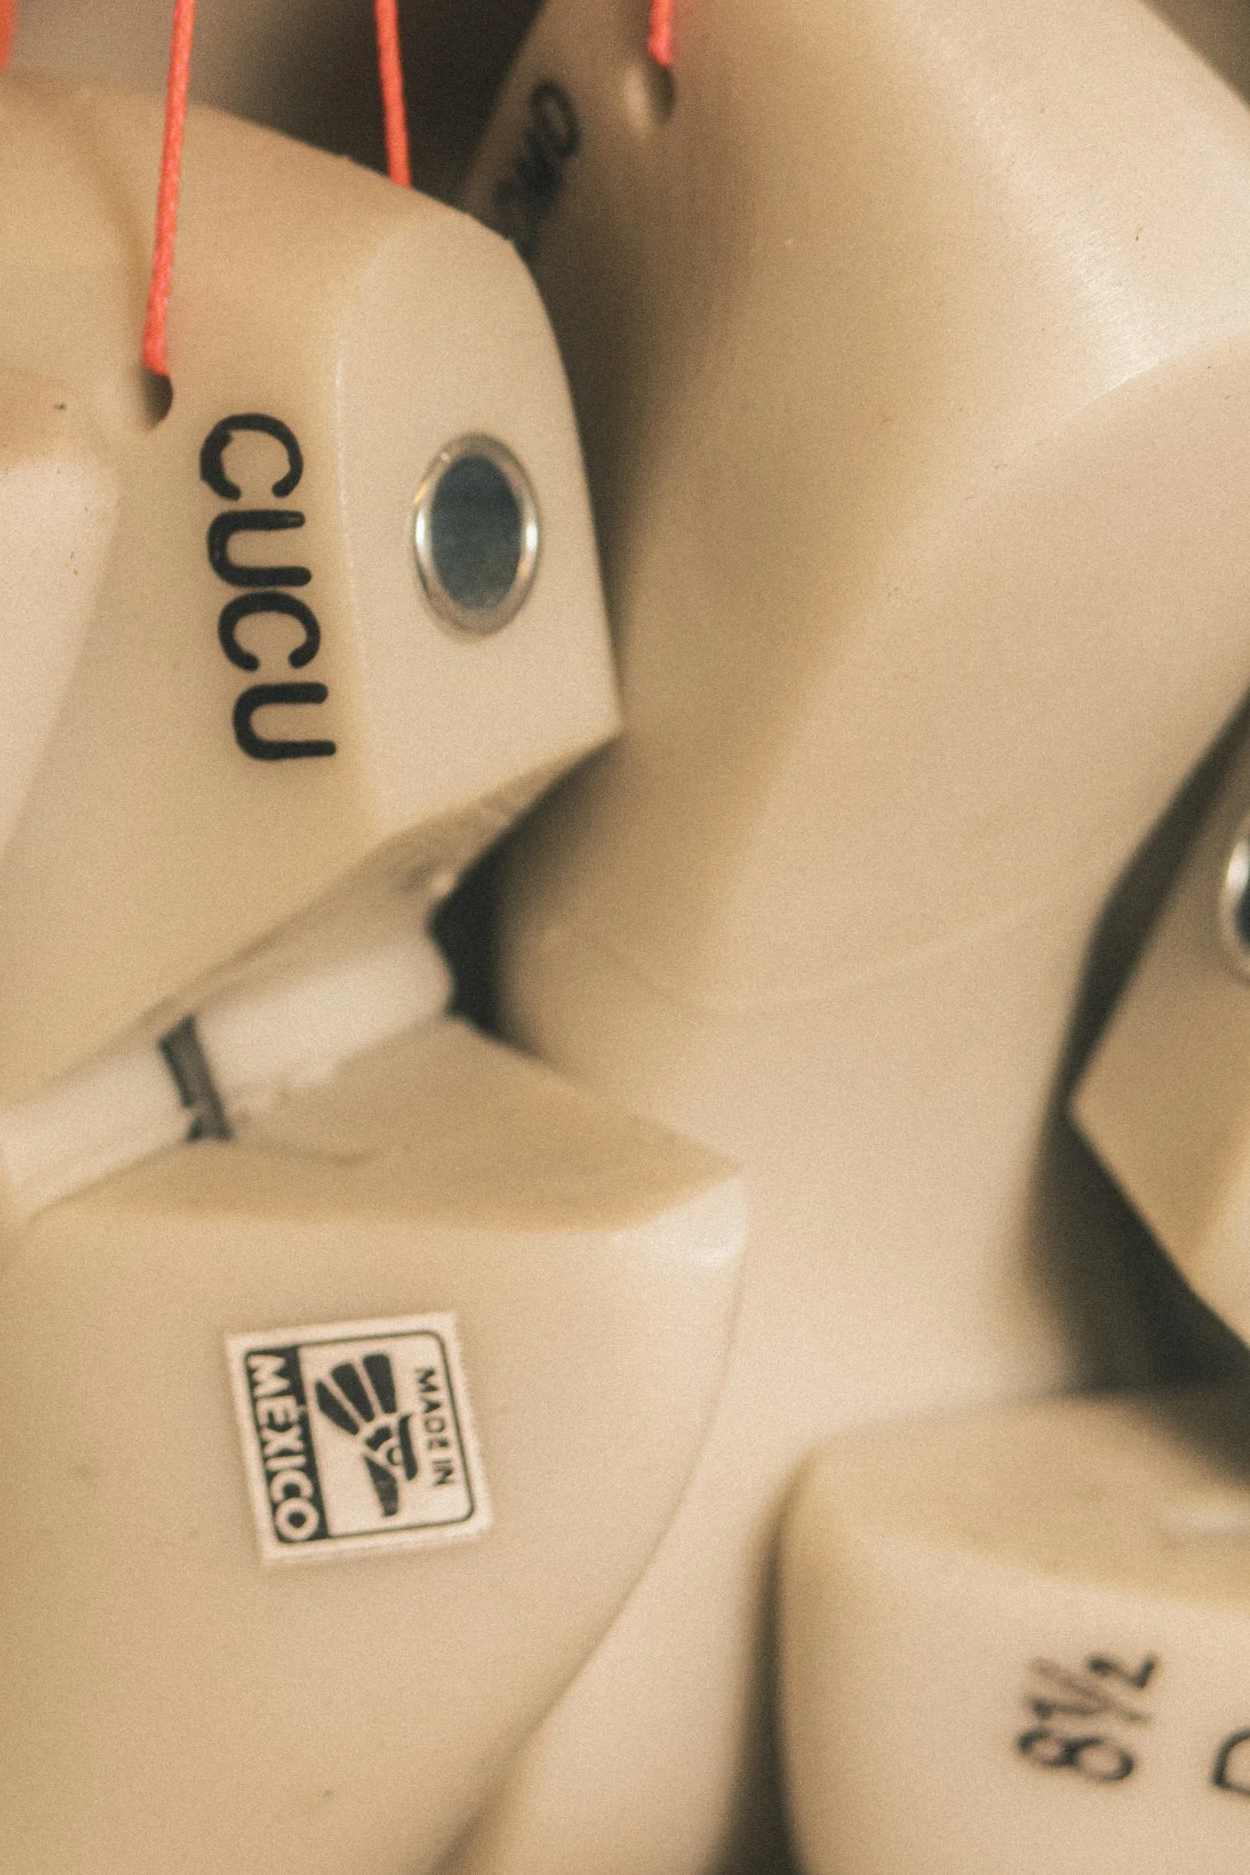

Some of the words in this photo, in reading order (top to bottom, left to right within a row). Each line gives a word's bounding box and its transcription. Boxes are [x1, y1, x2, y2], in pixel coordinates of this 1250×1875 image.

[200, 412, 337, 761] CUCU
[415, 1368, 449, 1451] MADE
[432, 1459, 455, 1487] IN
